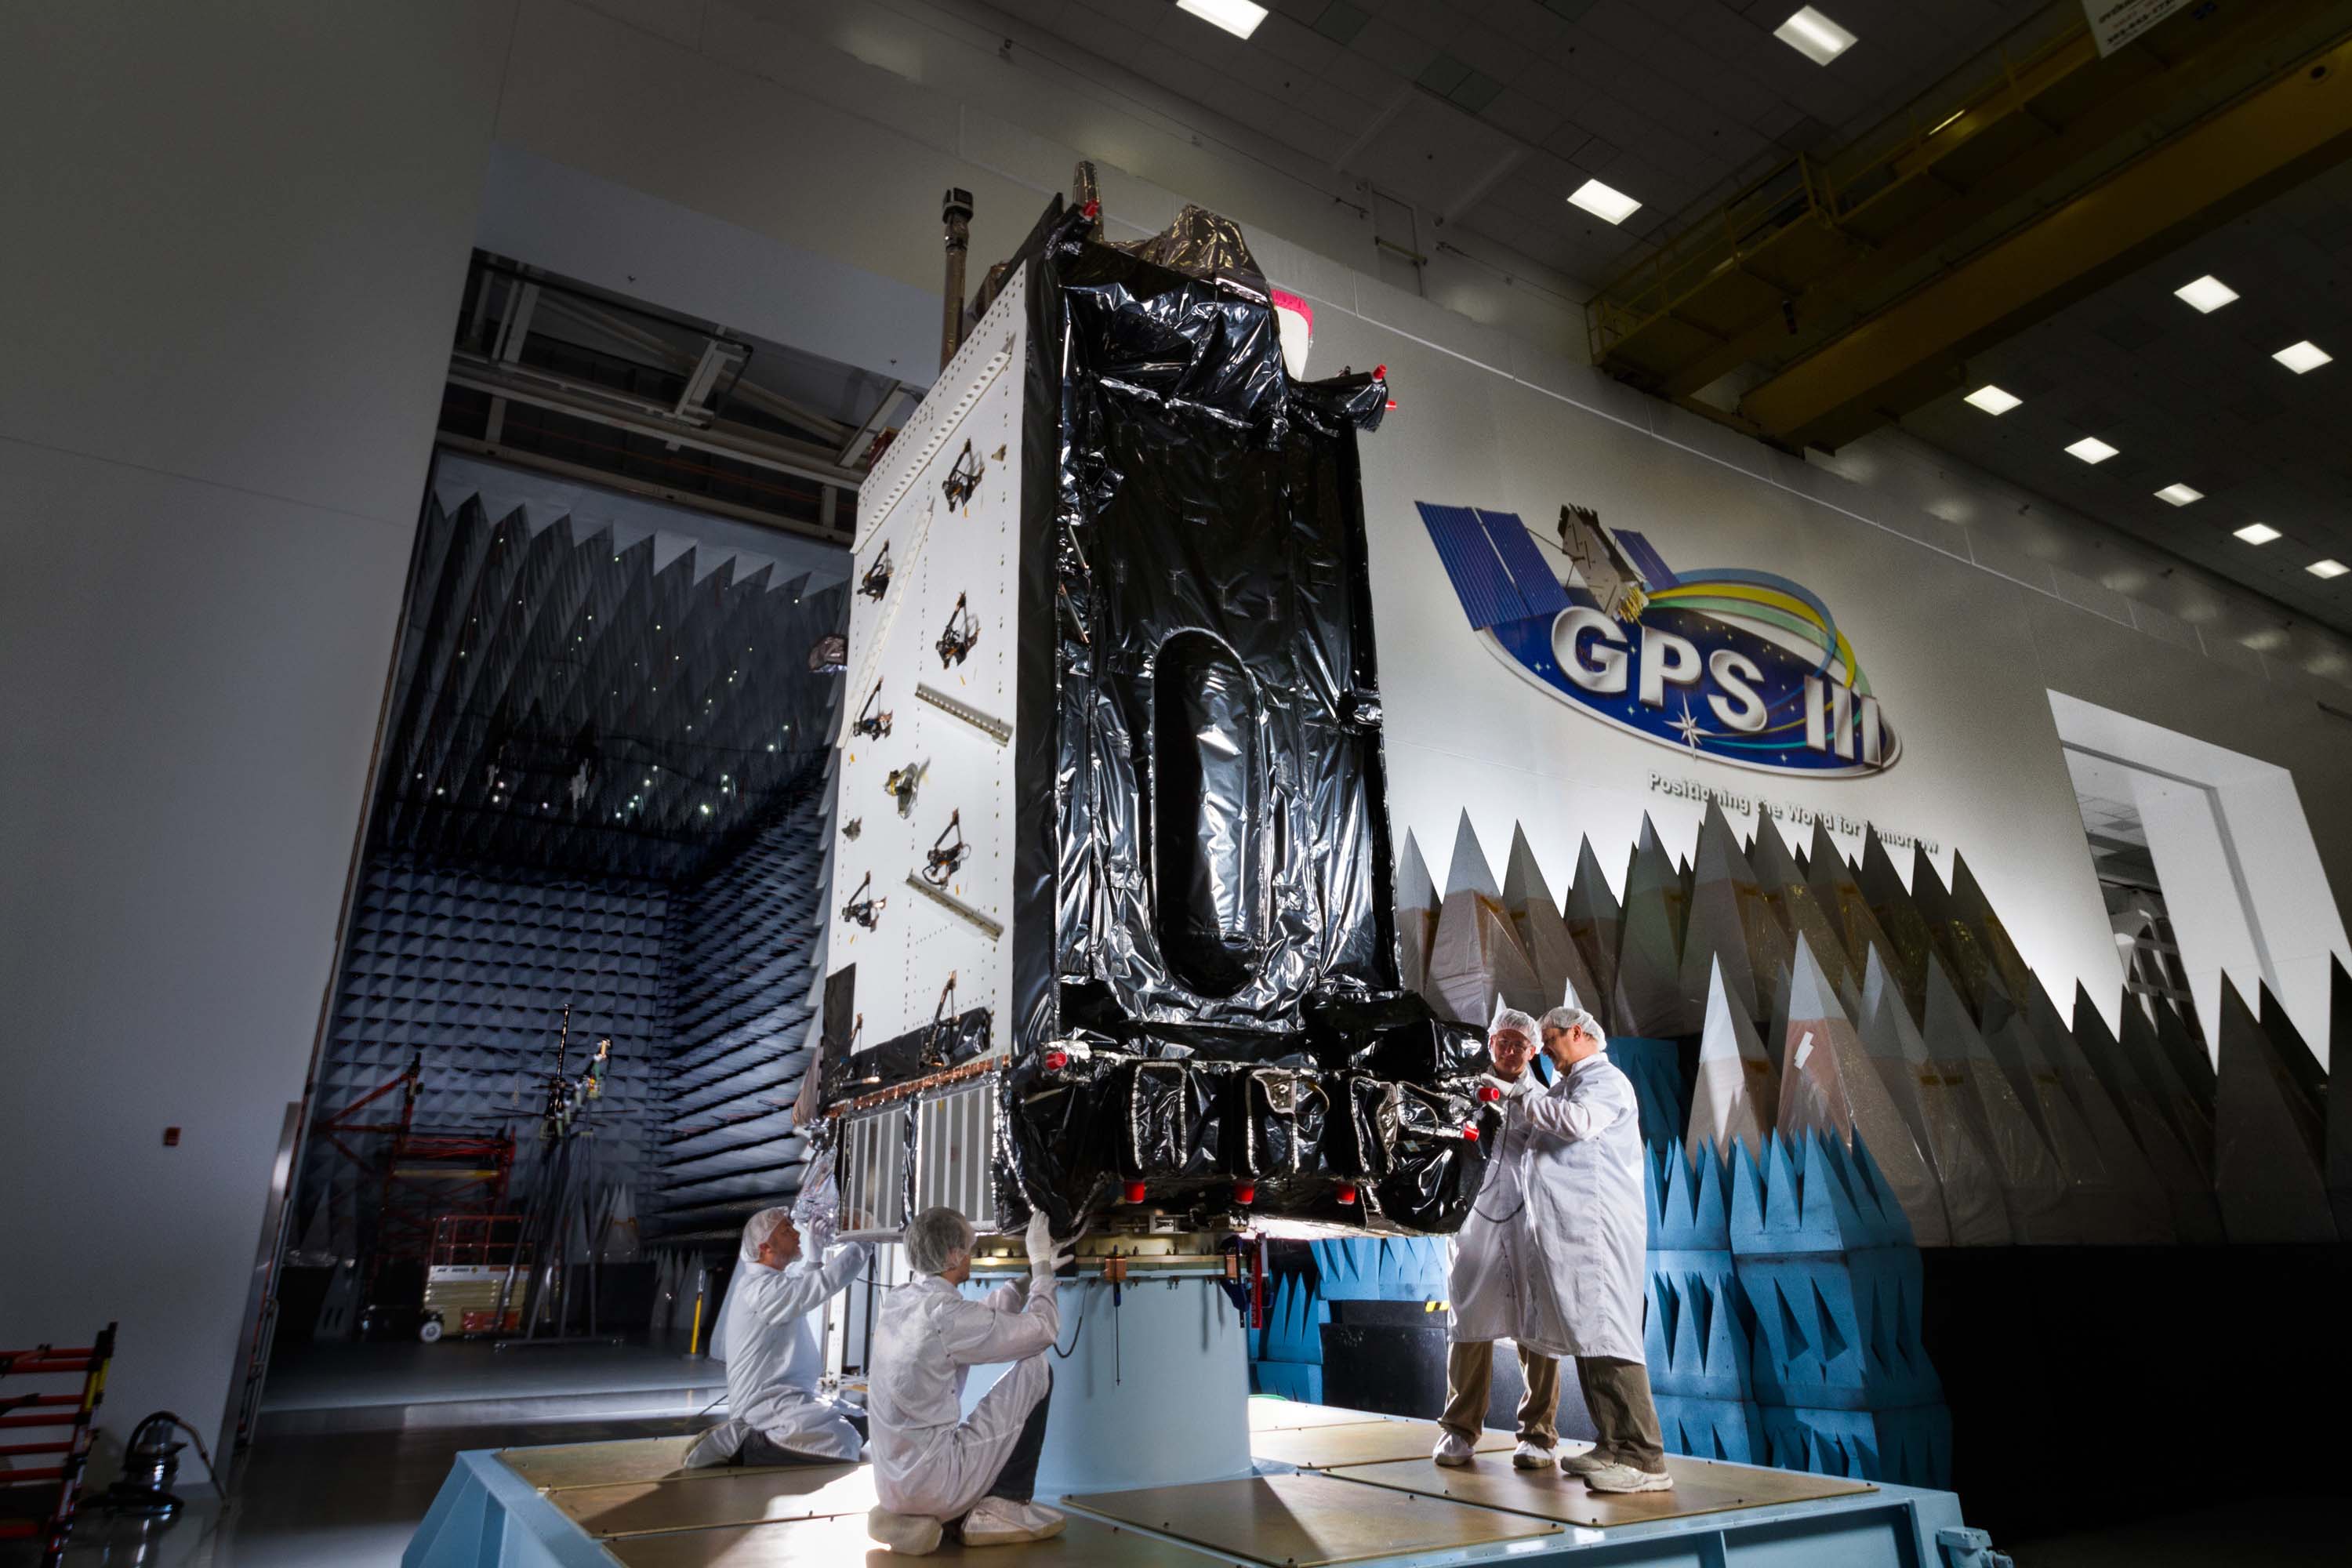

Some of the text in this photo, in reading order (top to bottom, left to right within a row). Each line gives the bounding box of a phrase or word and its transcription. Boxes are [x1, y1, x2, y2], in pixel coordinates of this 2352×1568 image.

[1551, 606, 1882, 767] GPS III
[1787, 801, 1834, 831] Wold
[1837, 815, 1860, 837] for
